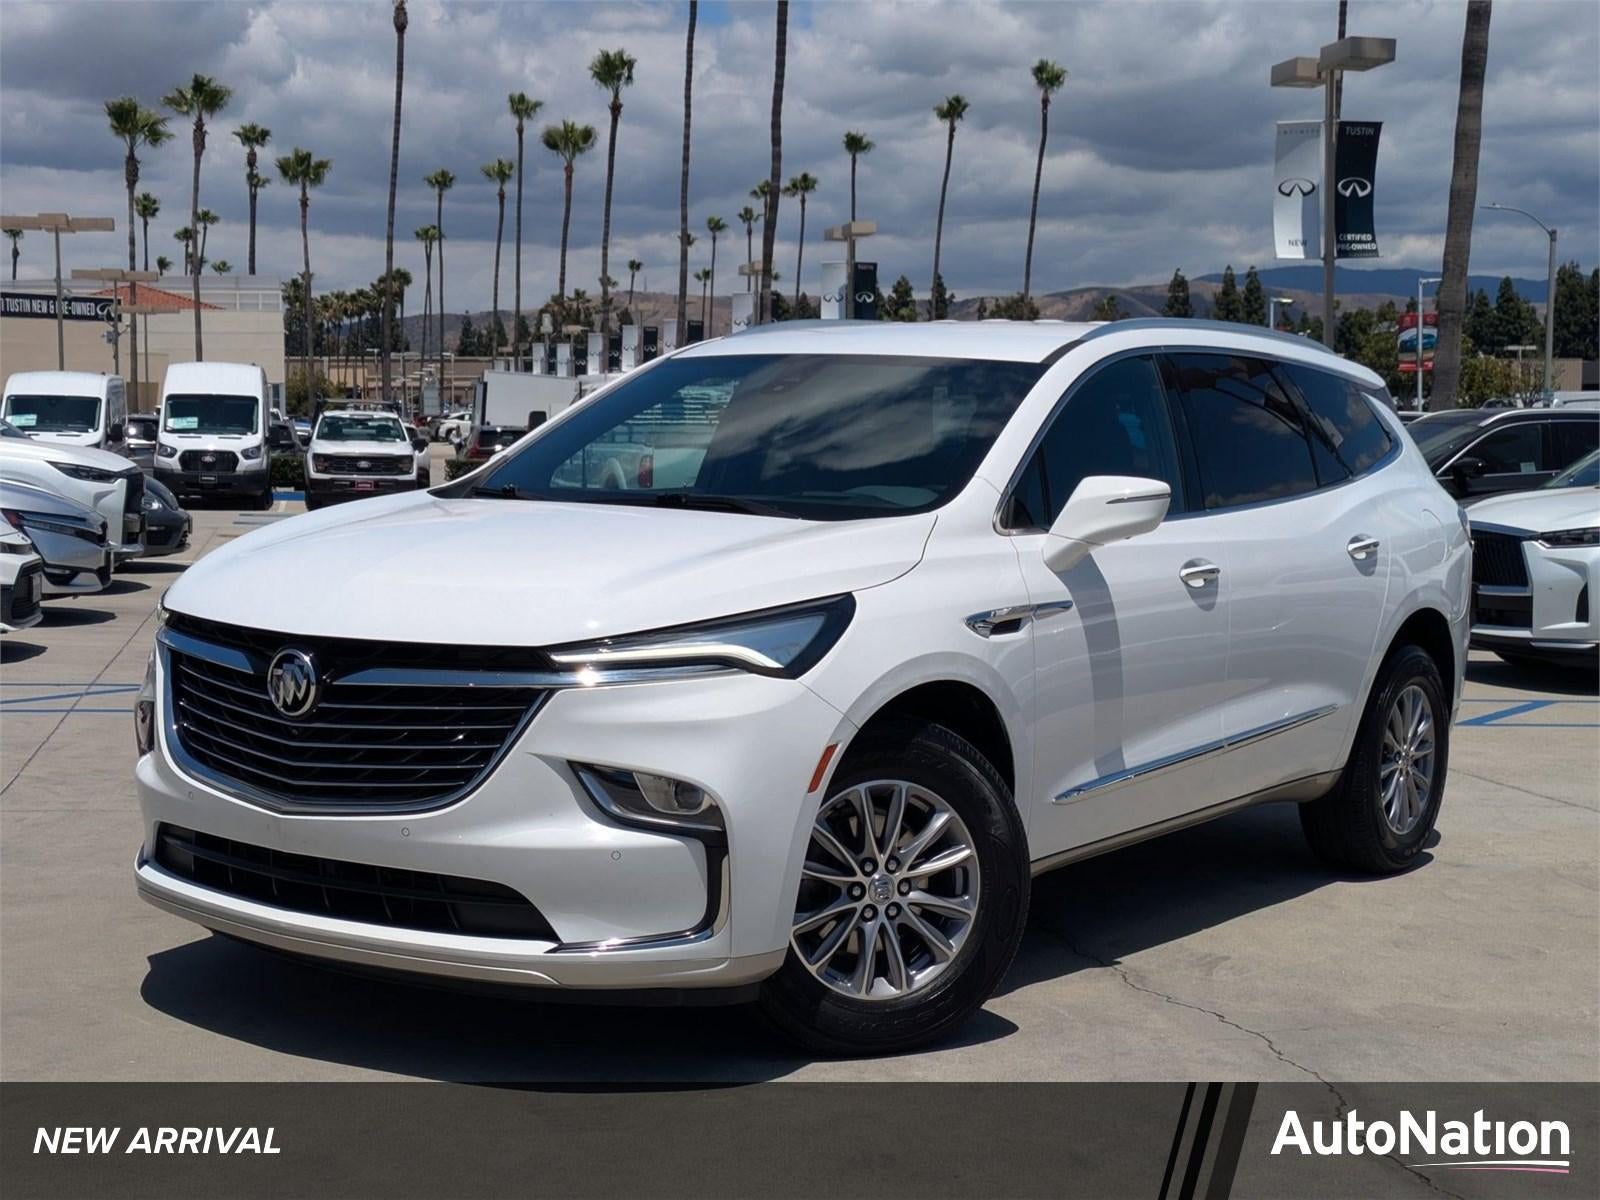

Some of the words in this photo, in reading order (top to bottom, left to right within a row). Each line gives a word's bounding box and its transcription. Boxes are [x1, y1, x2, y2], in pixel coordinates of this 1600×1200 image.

[1345, 127, 1375, 136] TUSTIN
[1288, 239, 1308, 248] NEW
[5, 297, 31, 313] TUSTIN
[32, 299, 48, 314] NEW
[49, 300, 55, 315] &
